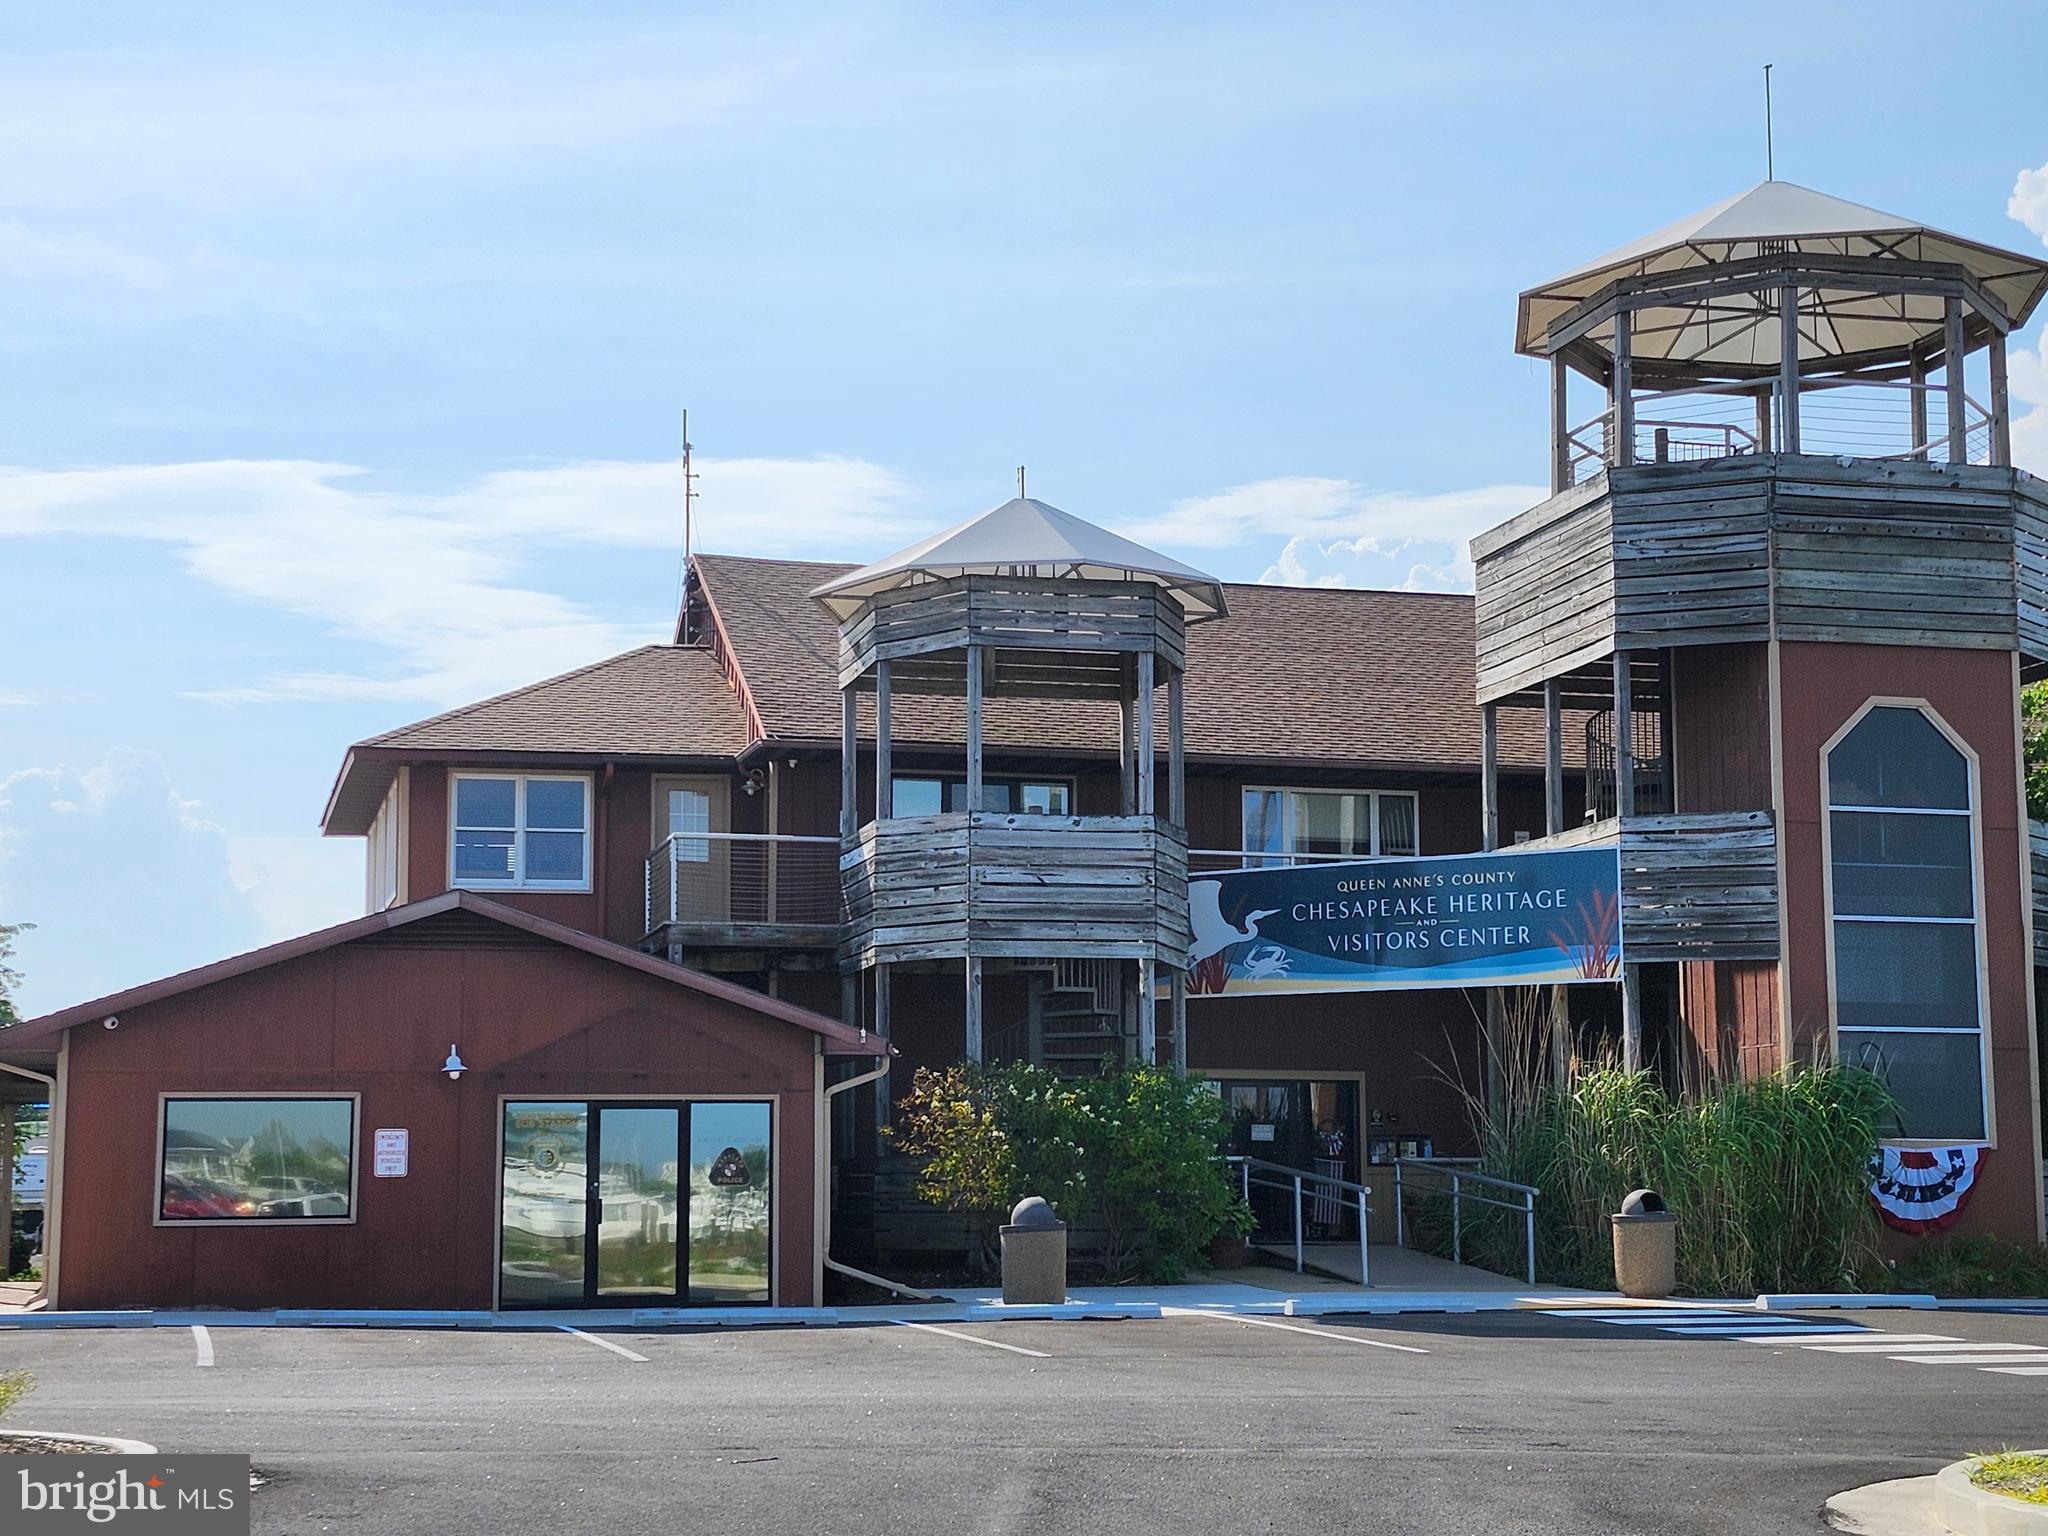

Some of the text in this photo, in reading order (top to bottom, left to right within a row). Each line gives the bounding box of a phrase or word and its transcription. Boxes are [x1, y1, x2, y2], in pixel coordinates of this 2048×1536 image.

[1337, 871, 1517, 893] QUEEN ANNE'S COUNTY
[1292, 888, 1568, 921] CHESAPEAKE HERITAGE
[1416, 918, 1438, 927] AND
[1327, 925, 1531, 952] VISITORS CENTER
[717, 1176, 744, 1184] POLICE
